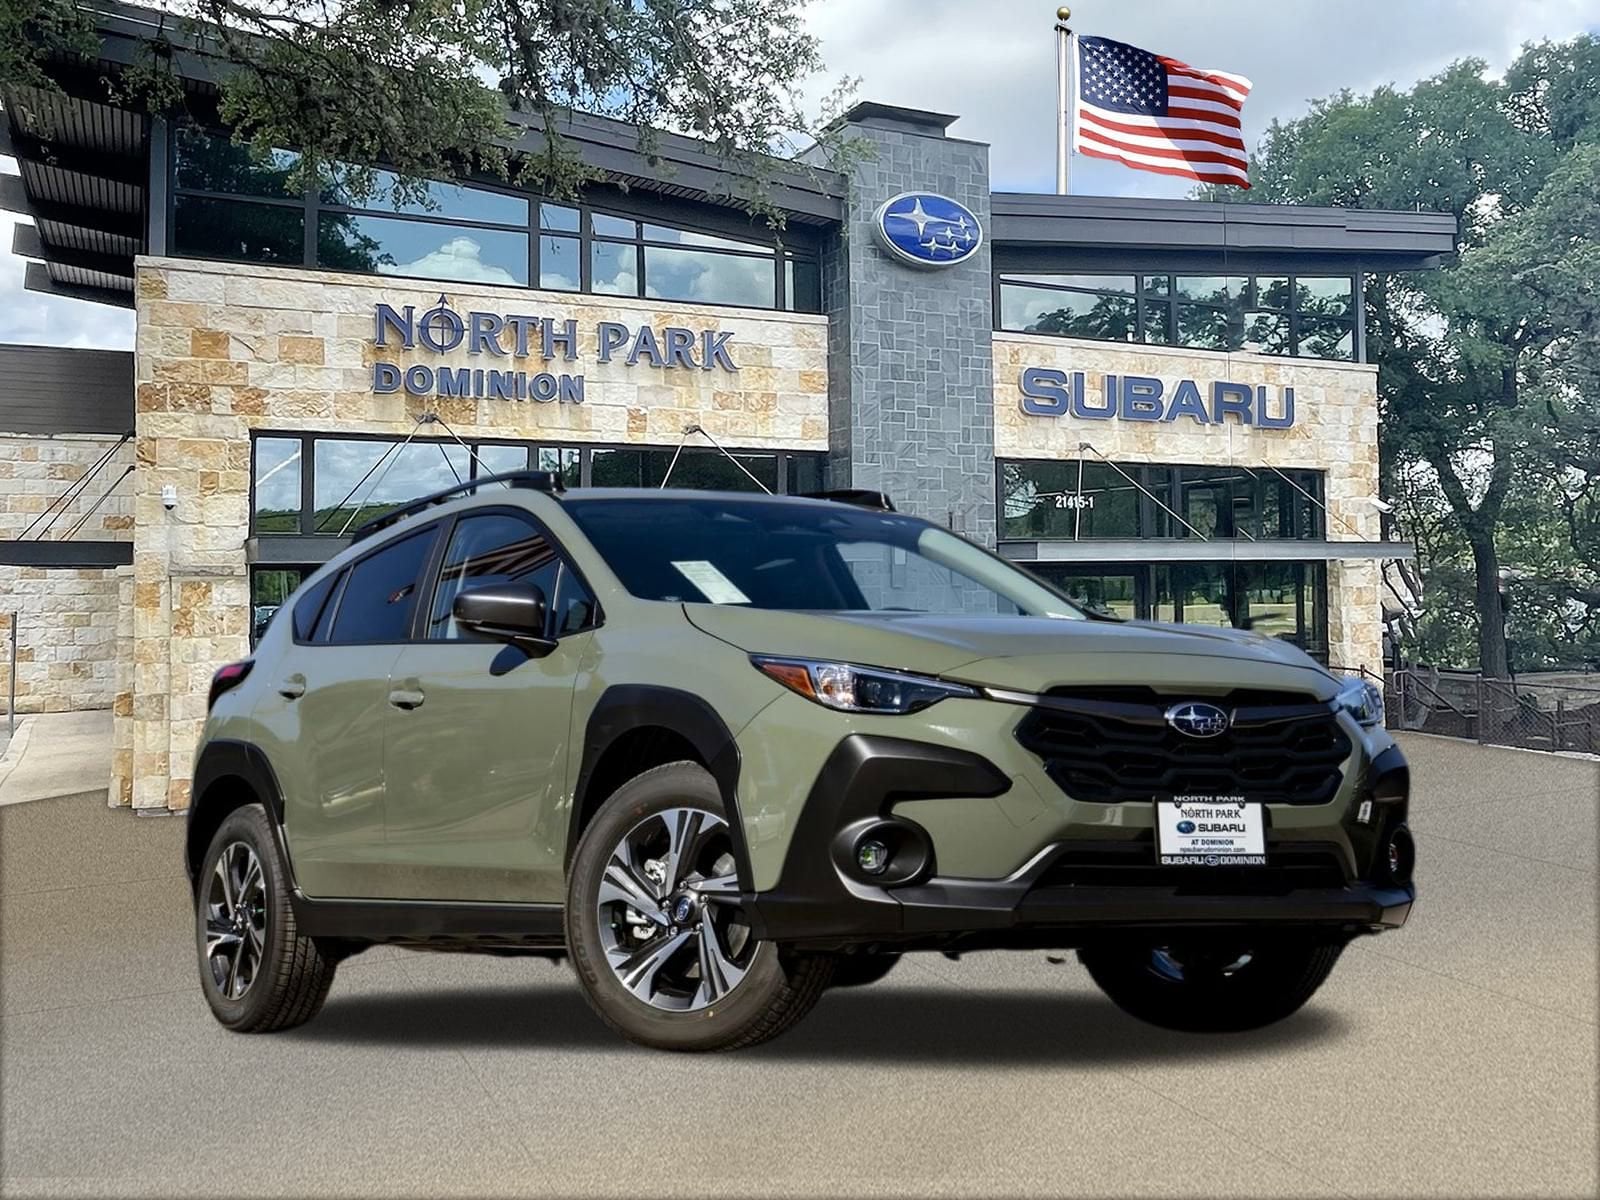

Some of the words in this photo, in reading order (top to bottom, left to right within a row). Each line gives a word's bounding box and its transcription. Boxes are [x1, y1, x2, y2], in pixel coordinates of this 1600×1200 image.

[374, 293, 579, 361] NORTH
[597, 321, 742, 372] PARK
[373, 362, 585, 405] DOMINION
[1019, 367, 1295, 429] SUBARU
[1181, 808, 1213, 819] NORTH
[1215, 809, 1242, 819] PARK
[1198, 824, 1246, 832] SUBARU
[1161, 856, 1204, 864] SUBARU
[1220, 856, 1266, 865] DOMINION
